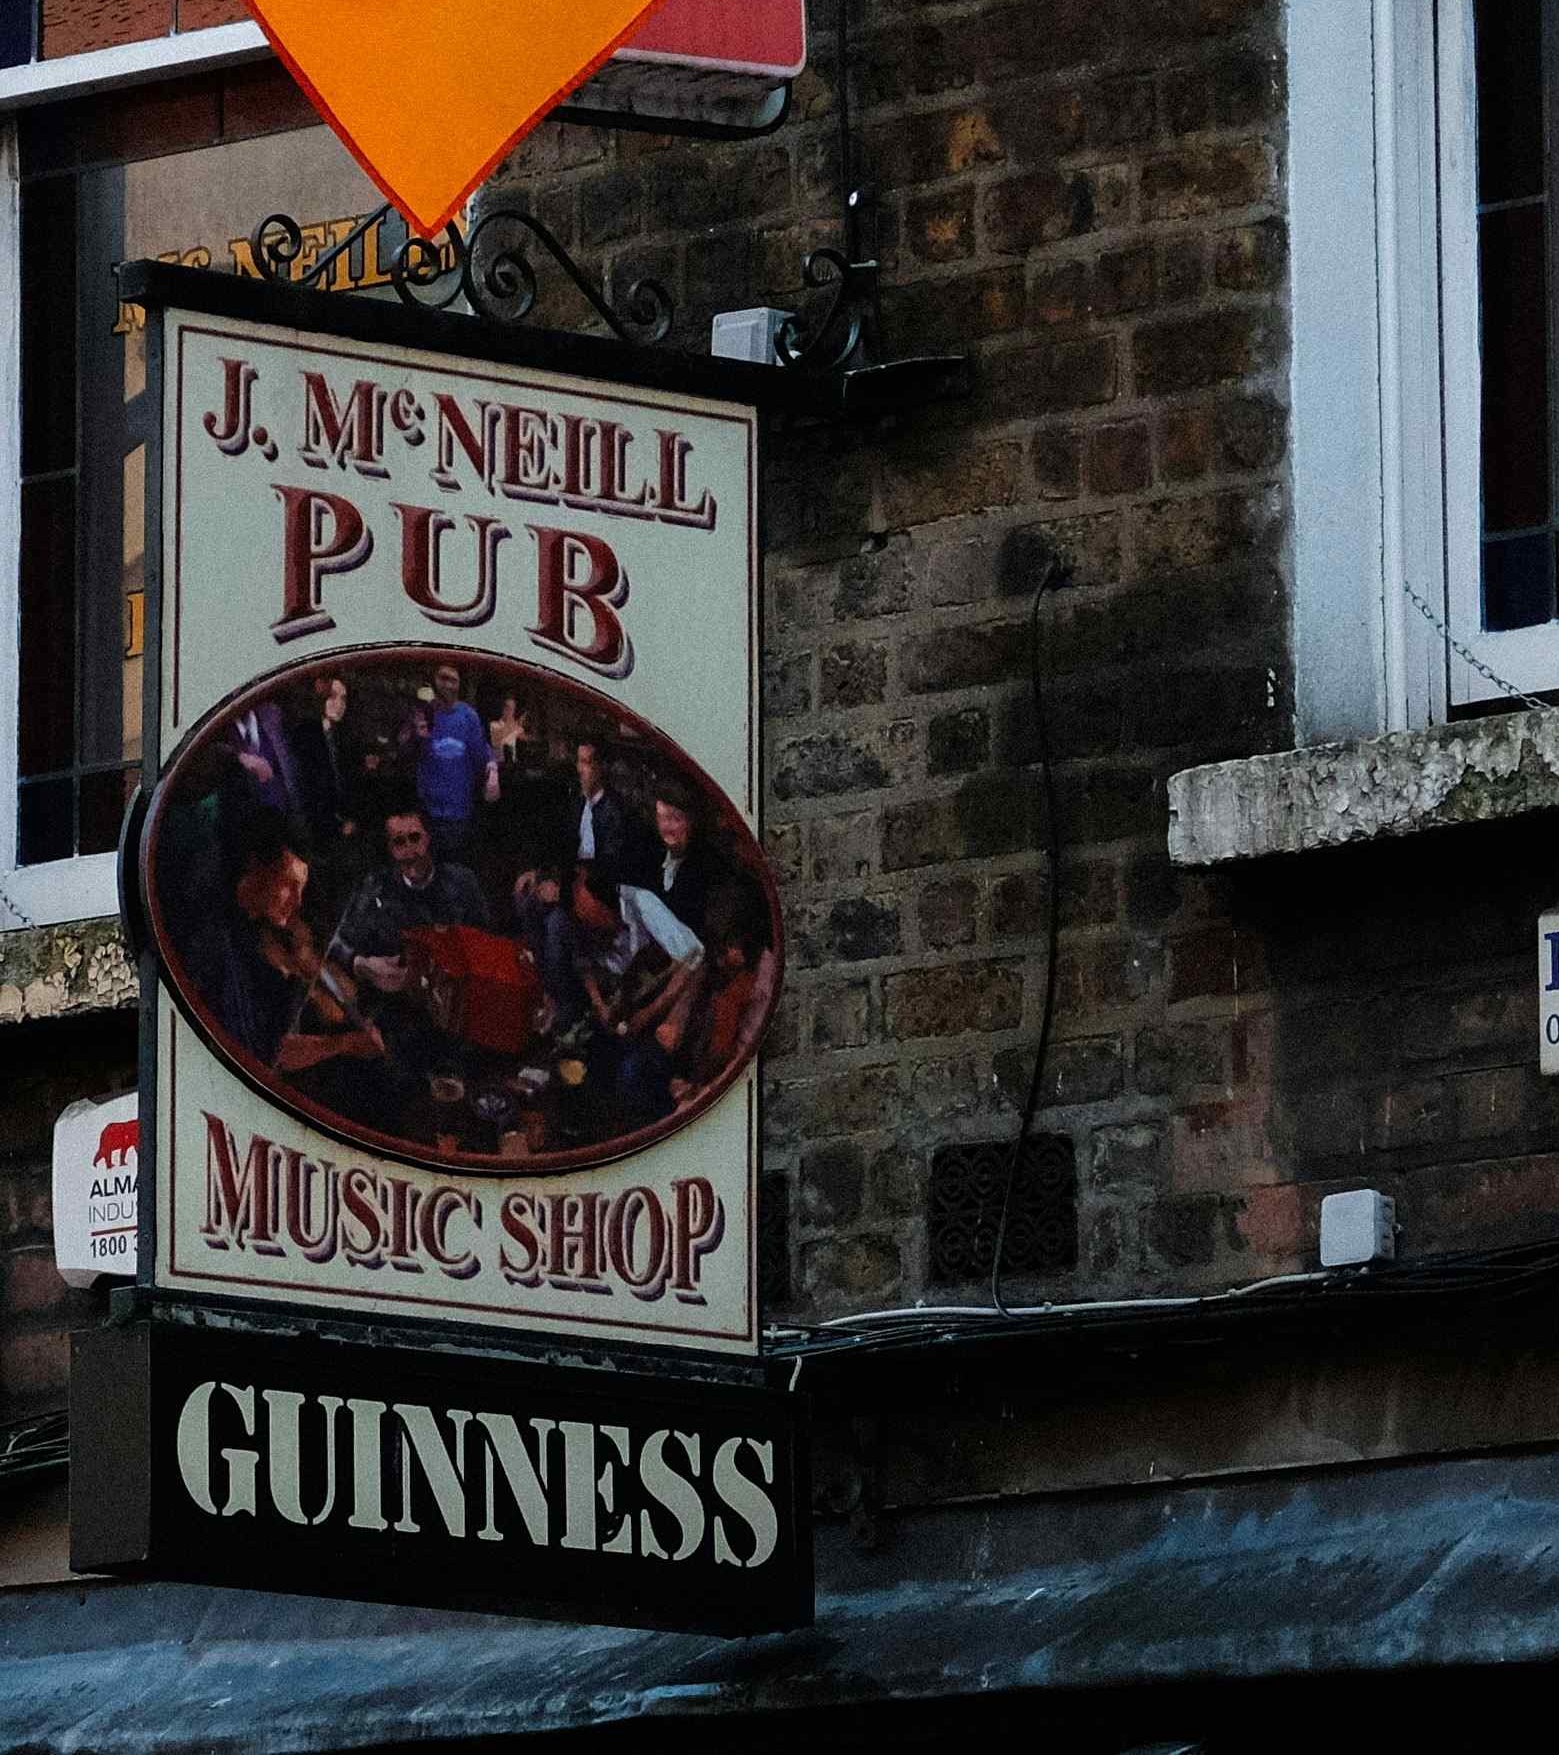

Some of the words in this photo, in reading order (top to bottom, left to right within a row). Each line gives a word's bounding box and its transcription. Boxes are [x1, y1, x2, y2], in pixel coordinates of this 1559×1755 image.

[204, 357, 278, 459] J.
[271, 484, 633, 679] PUB
[90, 1234, 127, 1258] 1800
[201, 1112, 480, 1278] MUSIC
[499, 1177, 725, 1305] SHOP
[176, 1380, 778, 1569] GUINNESS
